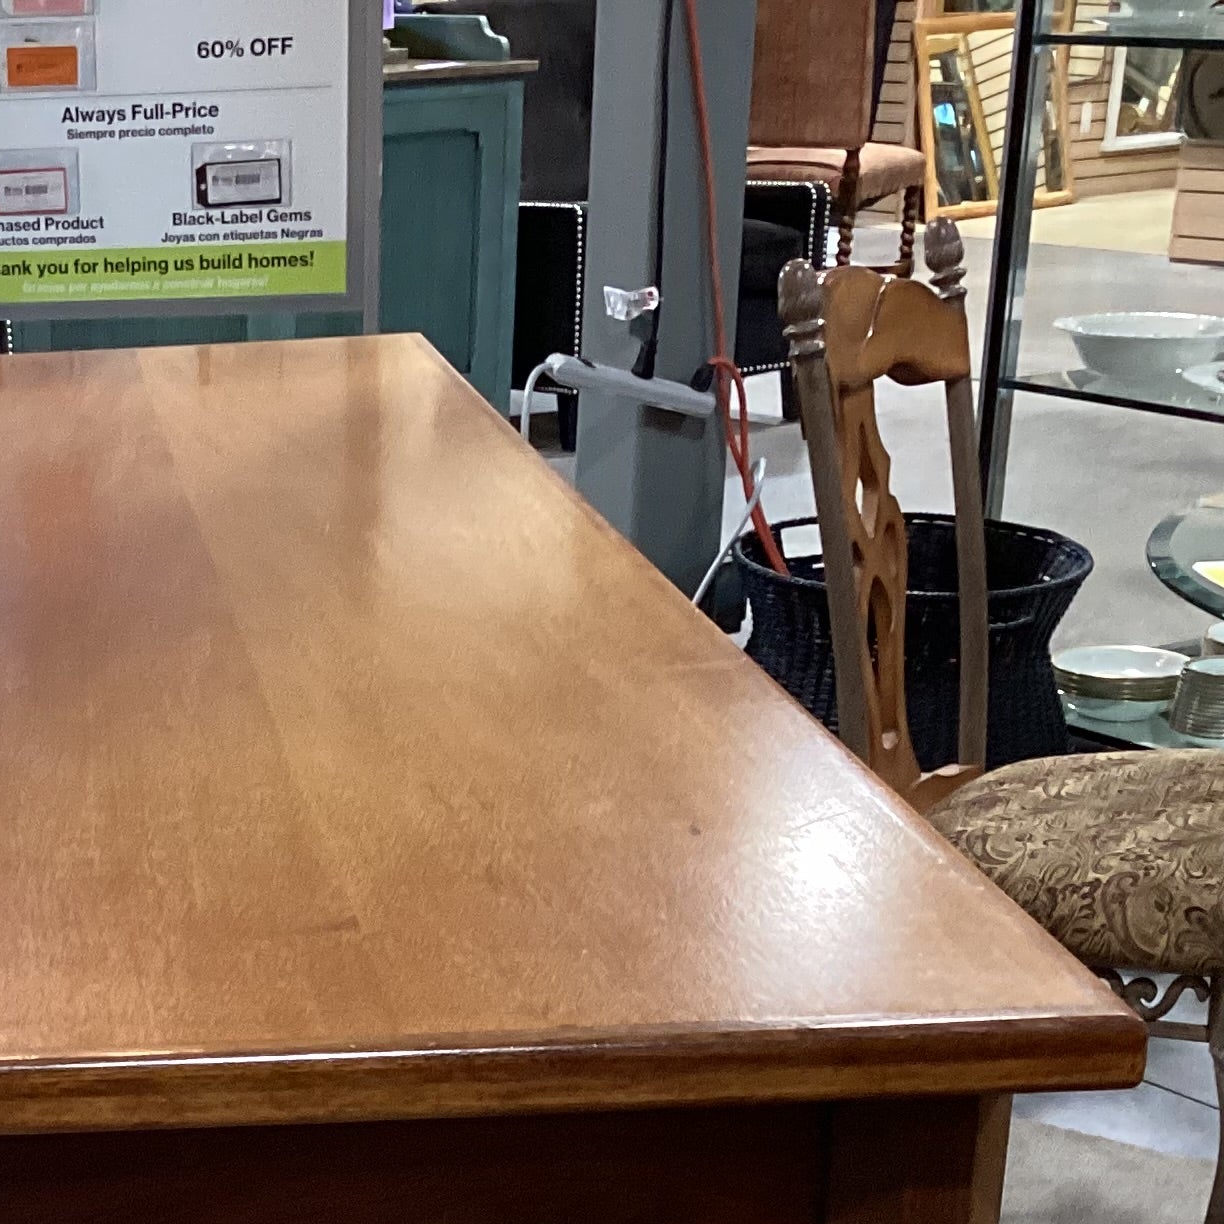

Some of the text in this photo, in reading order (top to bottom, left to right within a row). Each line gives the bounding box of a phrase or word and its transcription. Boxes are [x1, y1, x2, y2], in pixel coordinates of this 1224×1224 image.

[197, 37, 293, 58] 60% OFF
[61, 102, 219, 124] Always Full-Price
[67, 124, 214, 140] Siempre precio completo
[45, 216, 104, 230] Product
[172, 209, 312, 226] Black-Label Gems
[31, 234, 96, 246] comprados
[161, 228, 323, 244] Joyas con etiquetas Negras
[37, 262, 69, 278] you
[74, 259, 99, 273] for
[104, 256, 169, 275] helping
[174, 259, 194, 271] us
[199, 253, 243, 270] build
[248, 250, 314, 268] homes!
